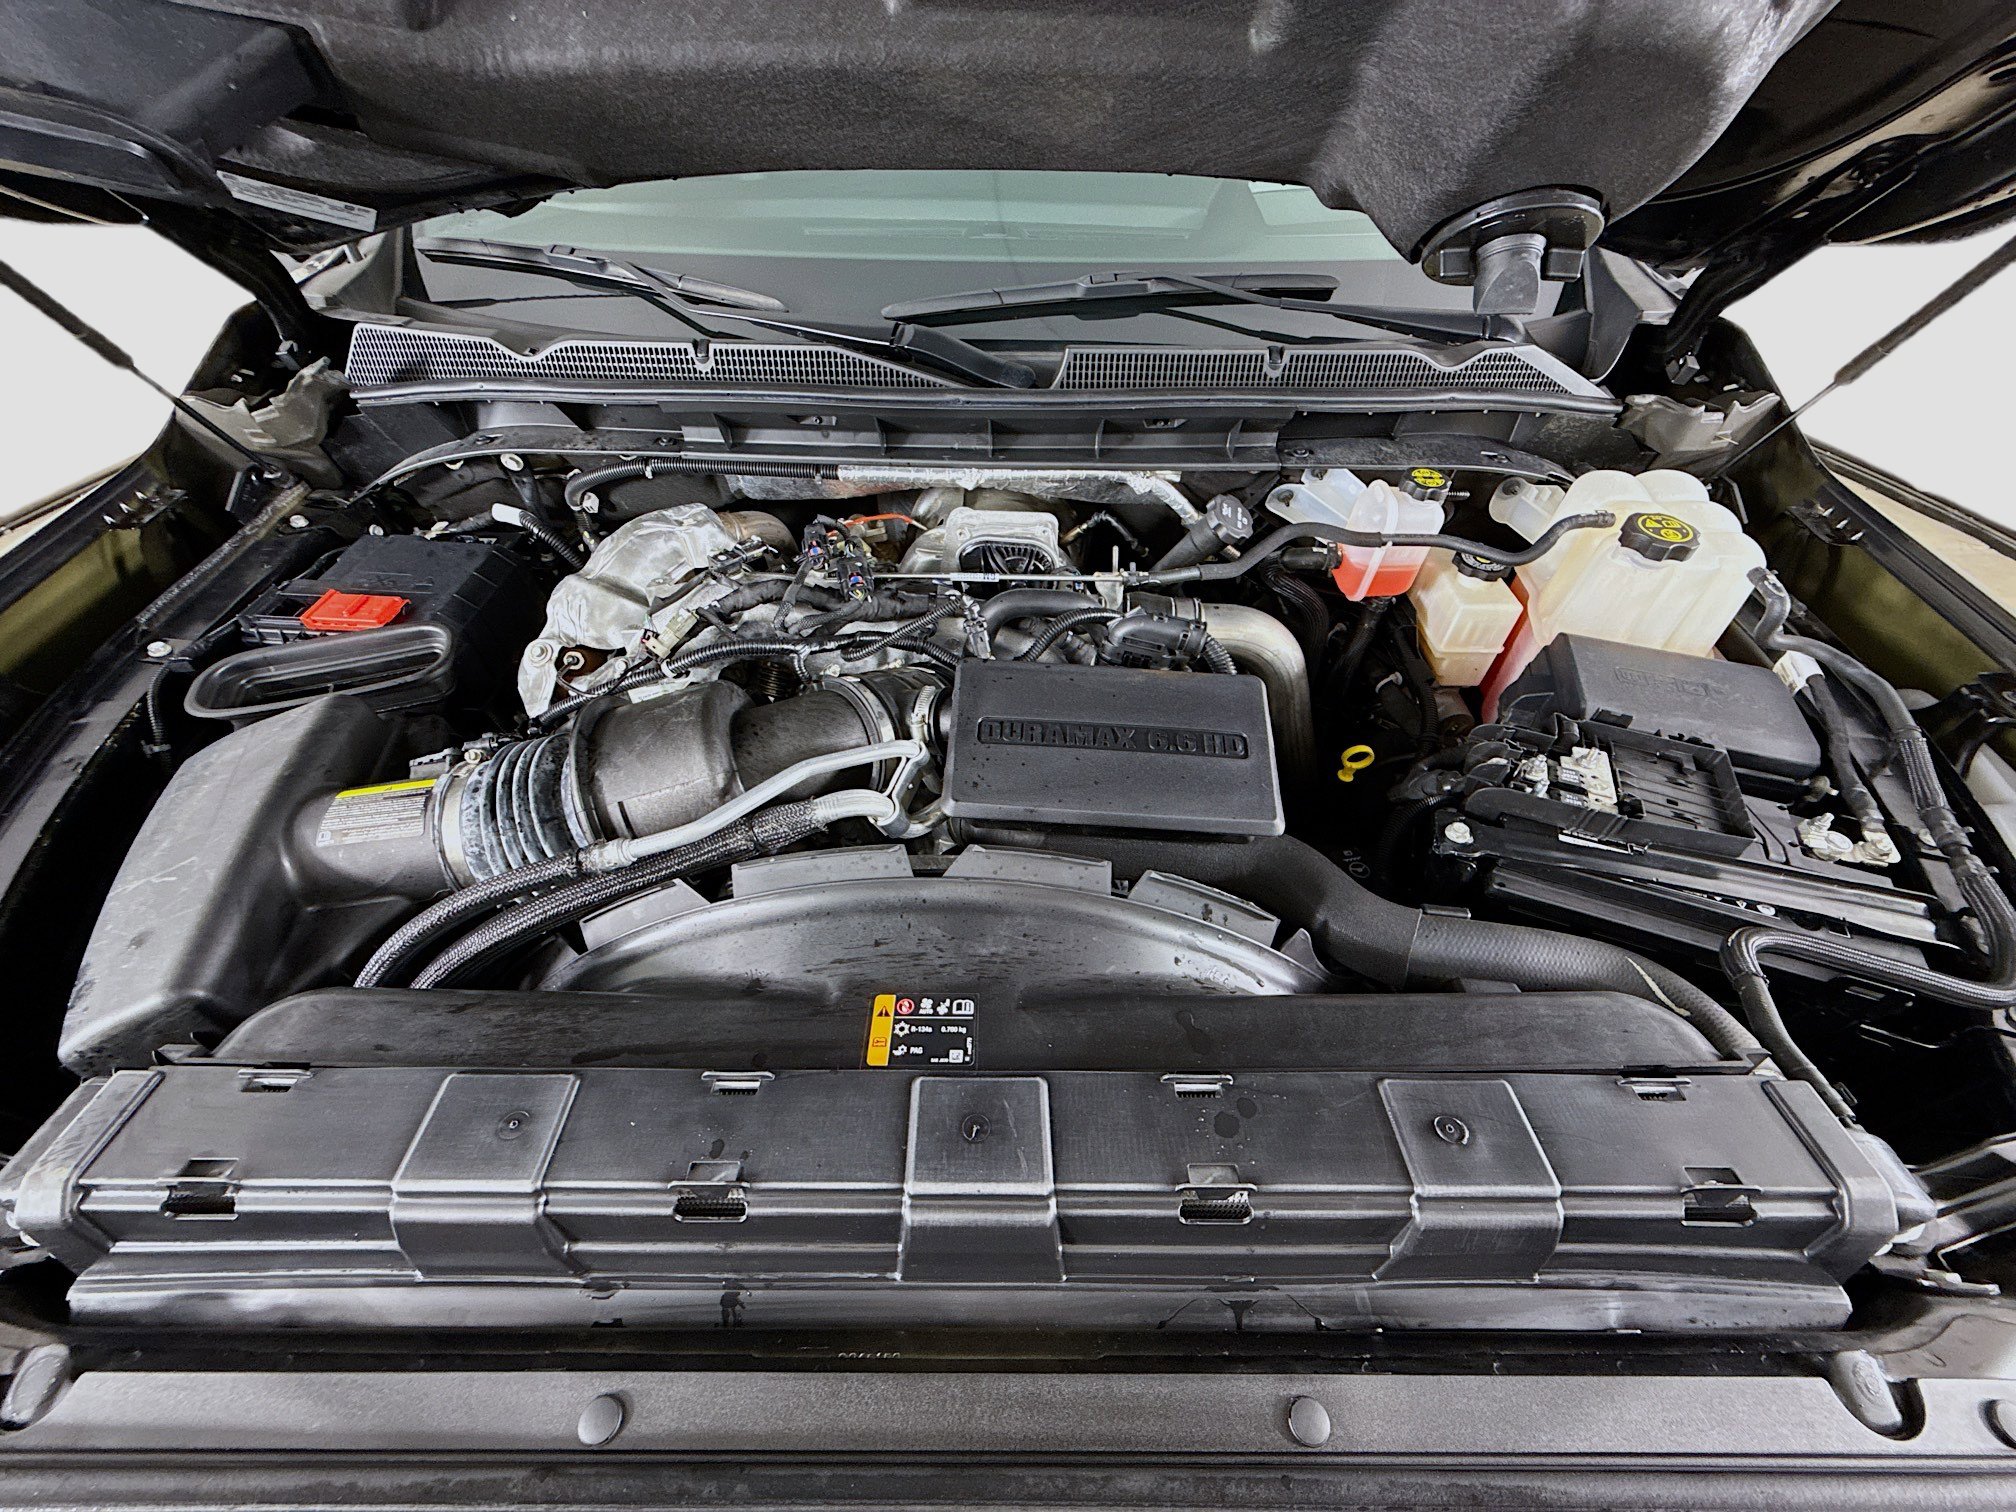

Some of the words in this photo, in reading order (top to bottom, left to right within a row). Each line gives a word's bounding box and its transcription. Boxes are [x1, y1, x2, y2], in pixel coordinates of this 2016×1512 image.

[980, 721, 1137, 749] DURAMAX
[1147, 730, 1197, 752] 6.6
[1203, 733, 1246, 756] HD
[909, 1047, 924, 1055] PAG
